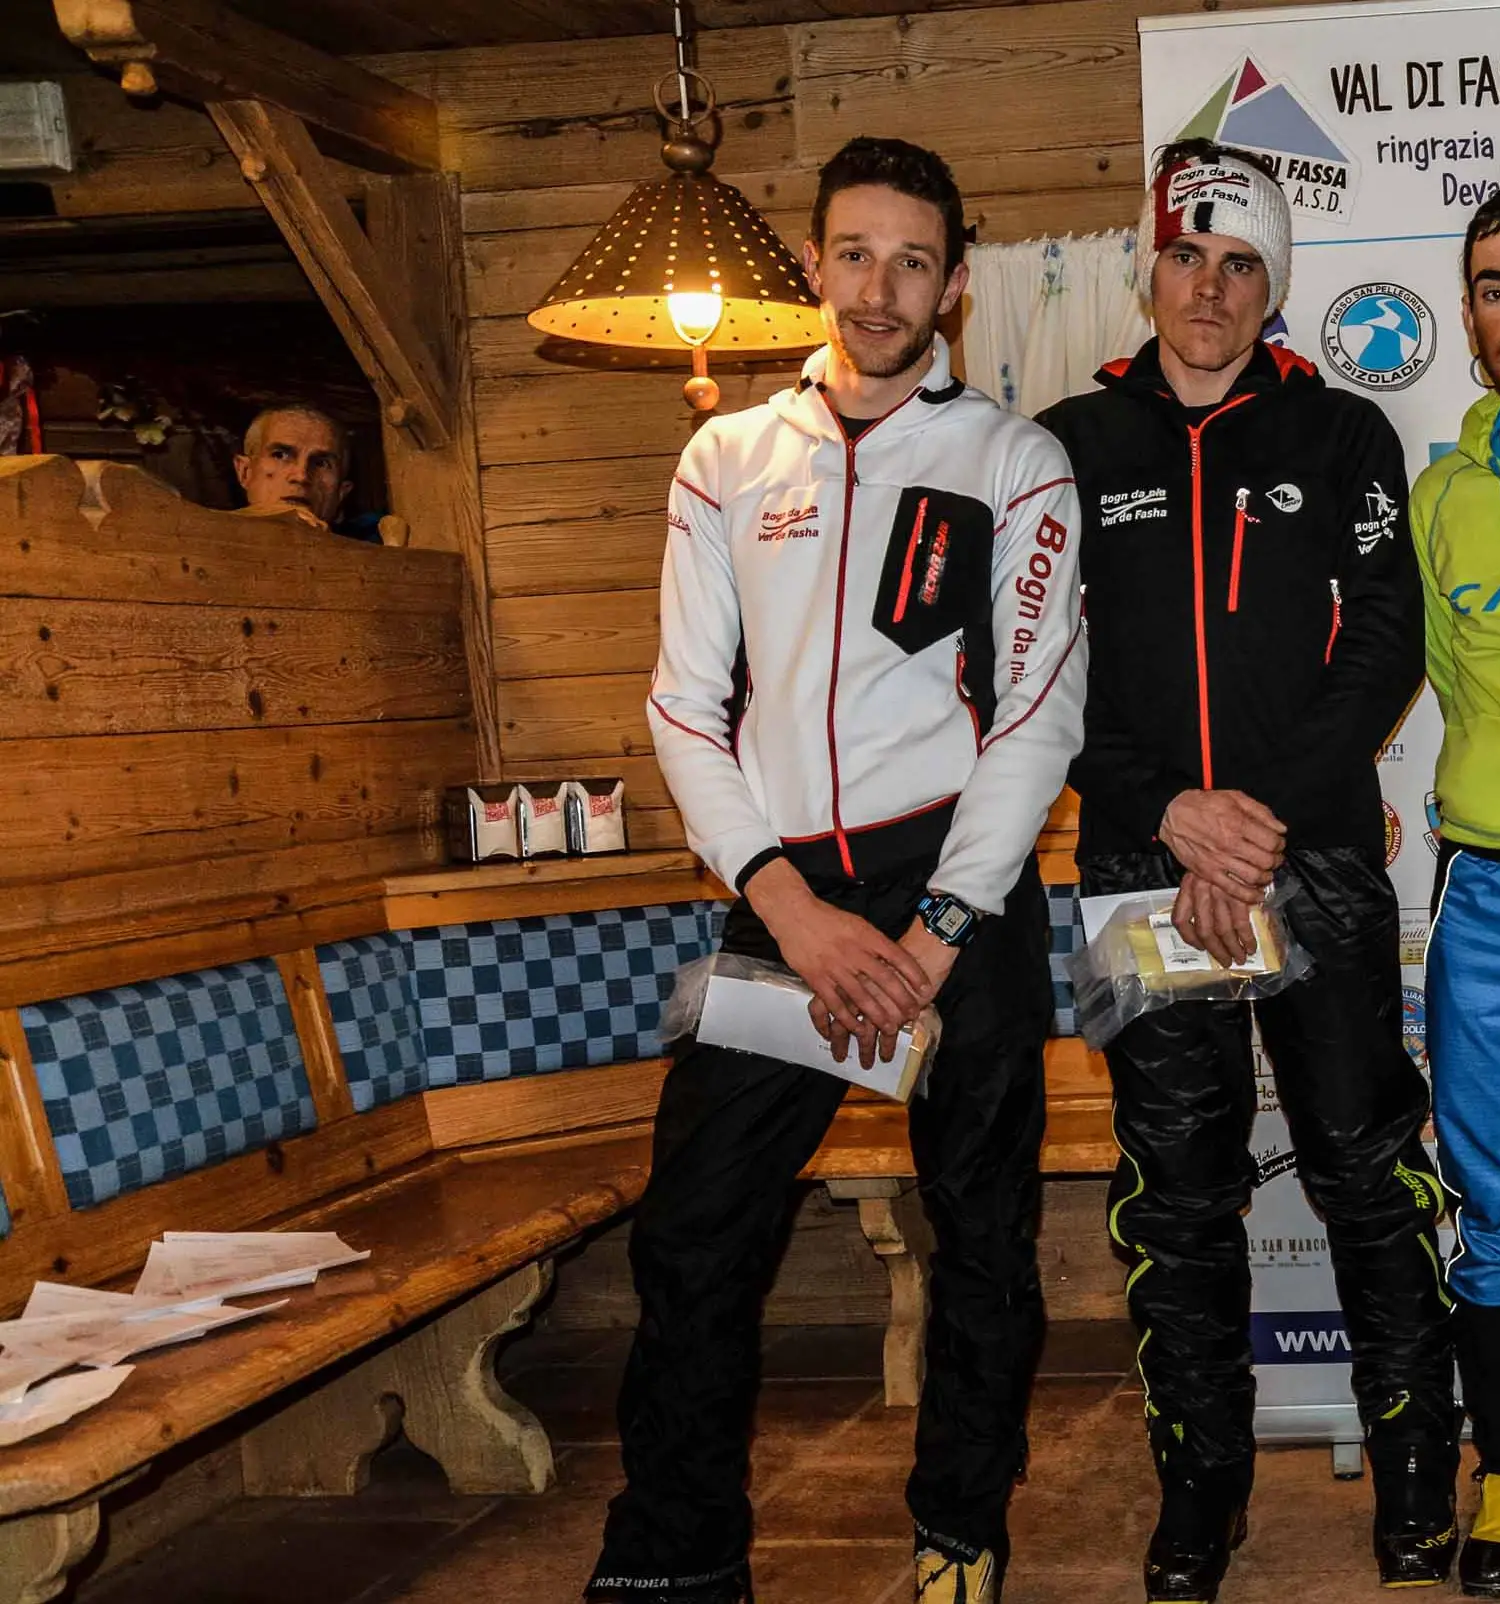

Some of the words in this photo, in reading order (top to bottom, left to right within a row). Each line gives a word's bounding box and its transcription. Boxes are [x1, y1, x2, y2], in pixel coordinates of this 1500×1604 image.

[1331, 63, 1393, 115] VAL
[1406, 61, 1445, 110] DI
[1376, 130, 1495, 171] ringrazia
[1209, 166, 1227, 178] da
[1286, 159, 1347, 190] FASSA
[1191, 186, 1207, 199] de
[1211, 188, 1249, 208] Fasha
[1292, 184, 1343, 214] A.S.D.
[1330, 296, 1353, 325] PASSO
[1353, 287, 1373, 300] SAN
[1375, 285, 1427, 320] PELLEGRINO
[1326, 336, 1340, 358] LA
[1340, 358, 1424, 384] PIZOLADA
[1100, 492, 1129, 505] Bogn
[1130, 489, 1145, 500] da
[1119, 511, 1132, 523] de
[1135, 507, 1168, 520] Fasha
[1354, 521, 1380, 534] Bogn
[787, 527, 819, 539] Fasha
[1015, 512, 1068, 622] Bogn
[1012, 627, 1038, 656] da
[1261, 1238, 1284, 1253] SAN
[1288, 1237, 1328, 1253] MARCO
